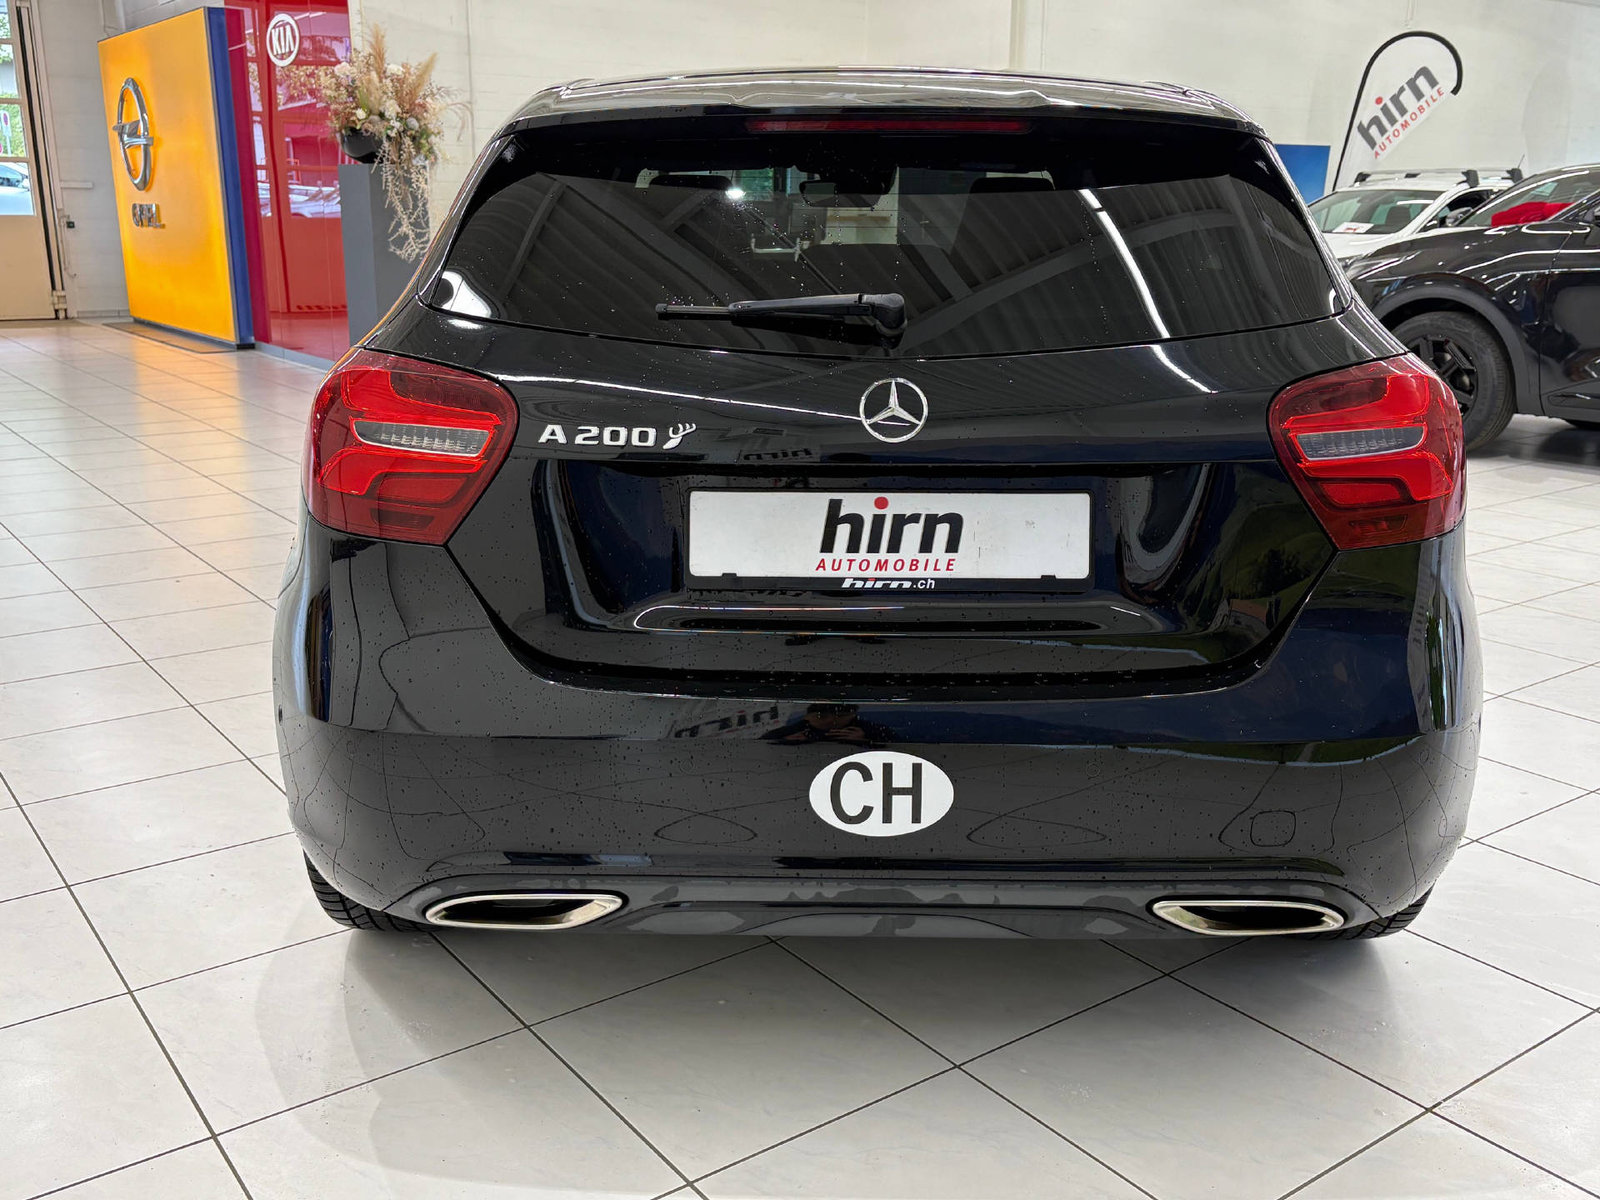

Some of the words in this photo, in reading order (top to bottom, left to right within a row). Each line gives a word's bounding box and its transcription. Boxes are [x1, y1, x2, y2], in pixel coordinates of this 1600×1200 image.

[271, 24, 295, 55] KIA
[1357, 66, 1439, 150] hirn
[1374, 86, 1444, 159] AUTOMOBILE
[538, 424, 568, 444] A
[574, 425, 657, 447] 200
[819, 496, 964, 554] hirn
[816, 557, 957, 573] AUTOMOBILE
[841, 577, 936, 590] hirn.ch
[830, 761, 923, 825] CH
